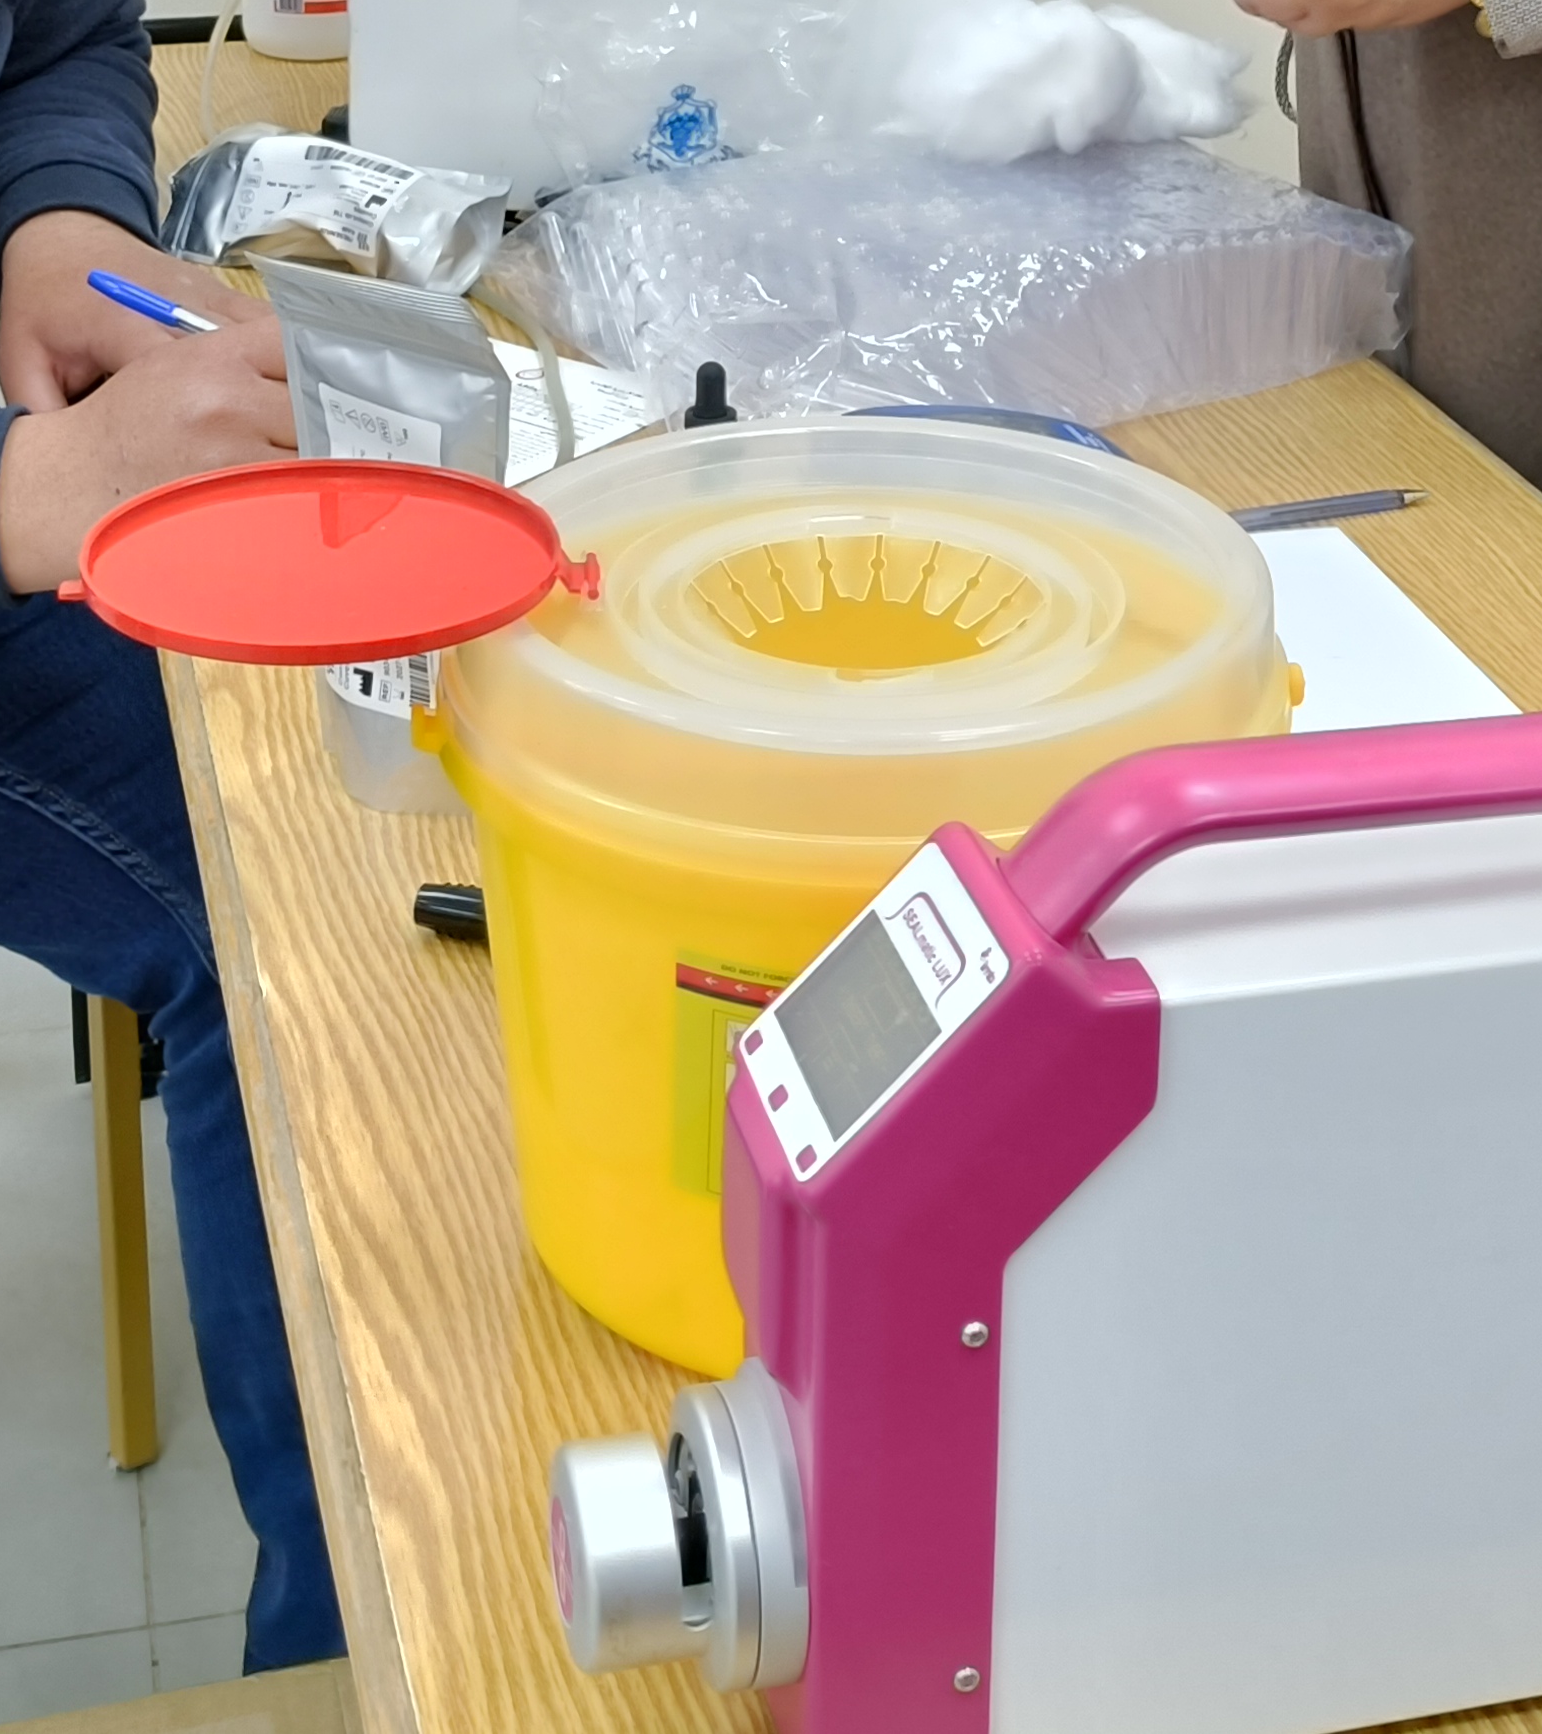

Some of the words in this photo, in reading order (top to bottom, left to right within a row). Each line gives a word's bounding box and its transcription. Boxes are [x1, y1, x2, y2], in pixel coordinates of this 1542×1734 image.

[902, 907, 936, 963] SEALmatic
[931, 958, 952, 986] LUX
[721, 964, 737, 973] DO
[739, 968, 760, 978] NOT
